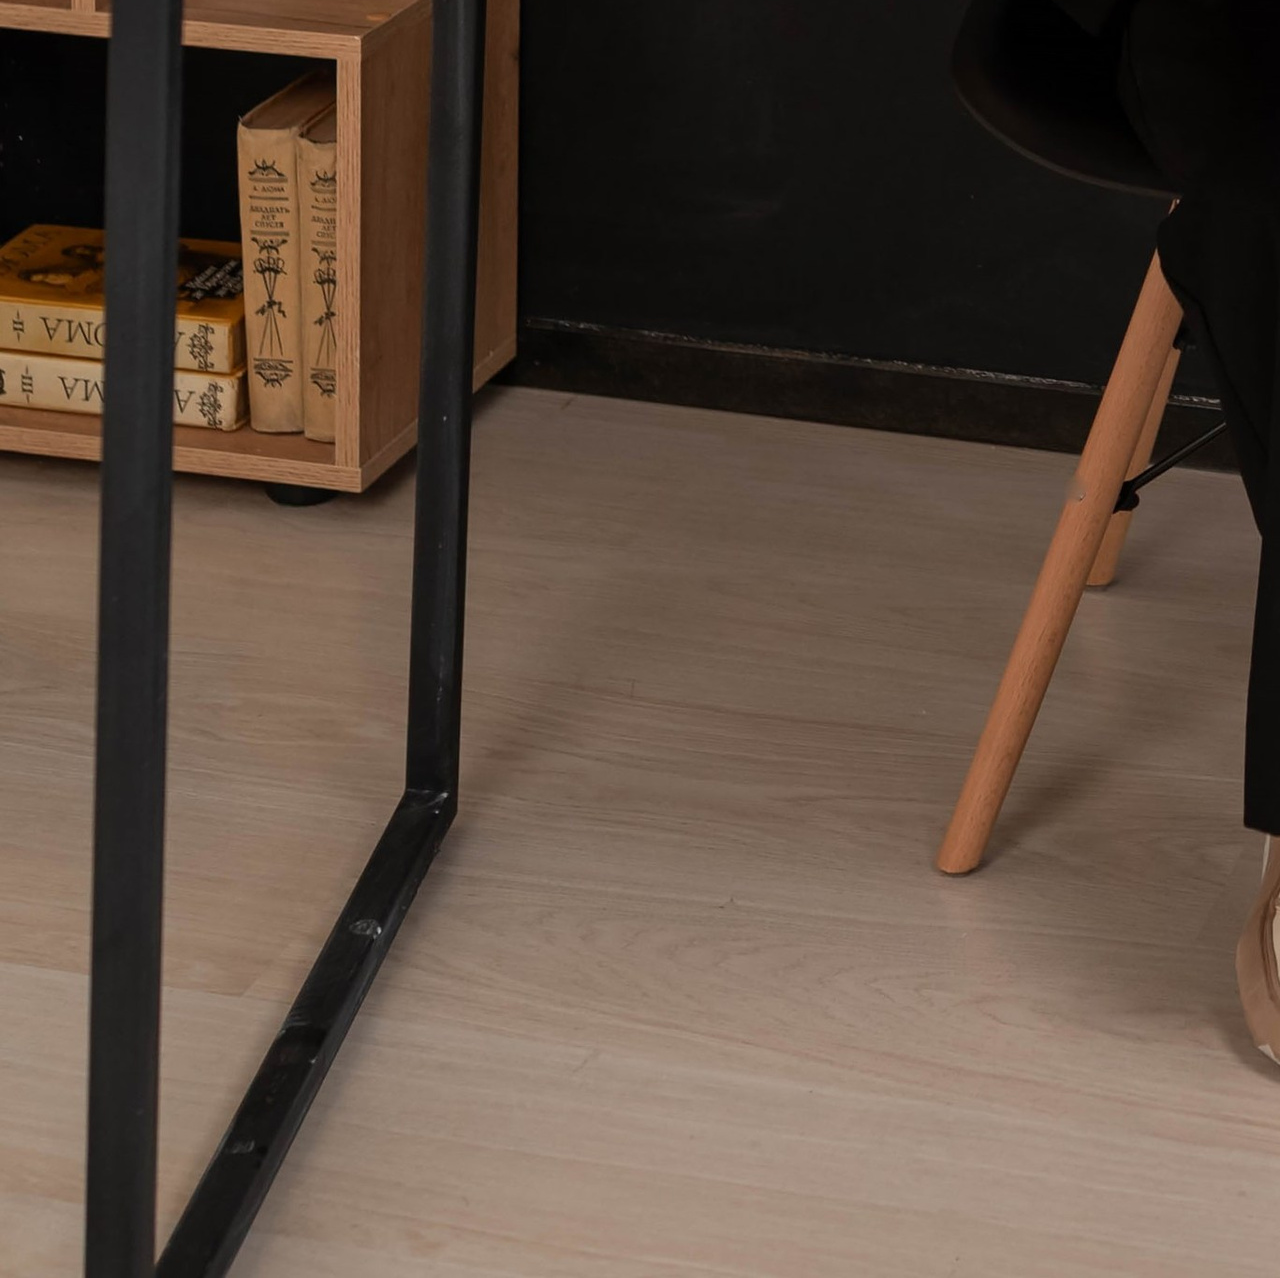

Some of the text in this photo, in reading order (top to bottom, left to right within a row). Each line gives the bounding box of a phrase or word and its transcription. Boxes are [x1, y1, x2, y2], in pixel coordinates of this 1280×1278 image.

[249, 204, 291, 214] ДВАДЦАТЬ
[260, 213, 277, 222] ЛЕТ
[254, 220, 285, 229] СПУСТЯ
